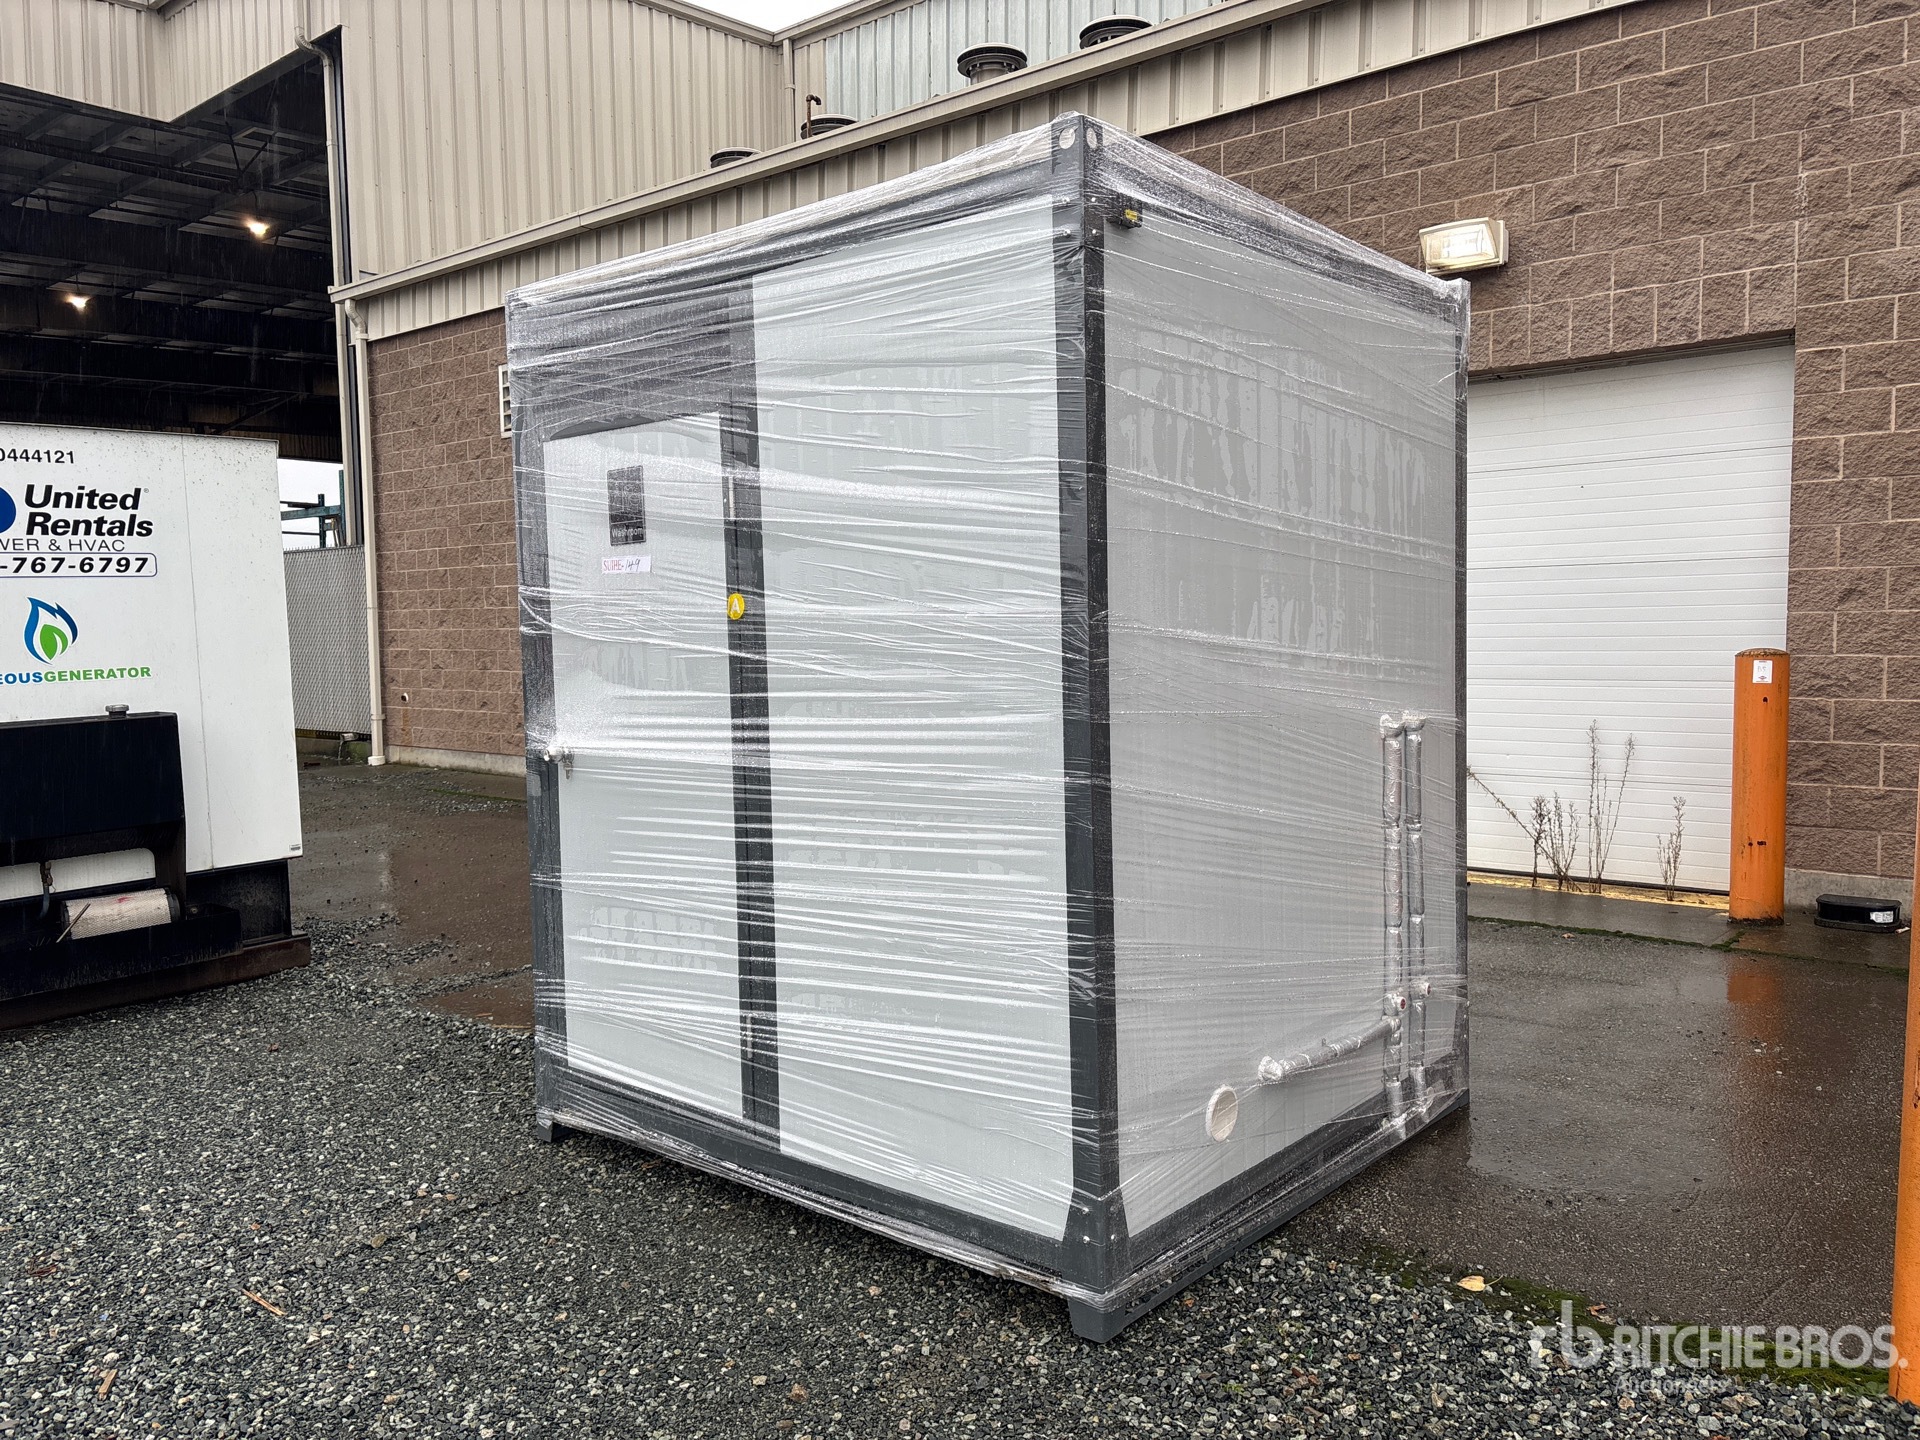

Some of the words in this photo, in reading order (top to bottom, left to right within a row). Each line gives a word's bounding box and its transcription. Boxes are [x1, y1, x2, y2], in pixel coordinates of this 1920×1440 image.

[24, 484, 142, 511] United
[26, 511, 154, 537] Rentals
[611, 526, 644, 538] Washroom
[48, 538, 62, 551] &
[68, 539, 126, 552] HVAC
[730, 600, 741, 614] A
